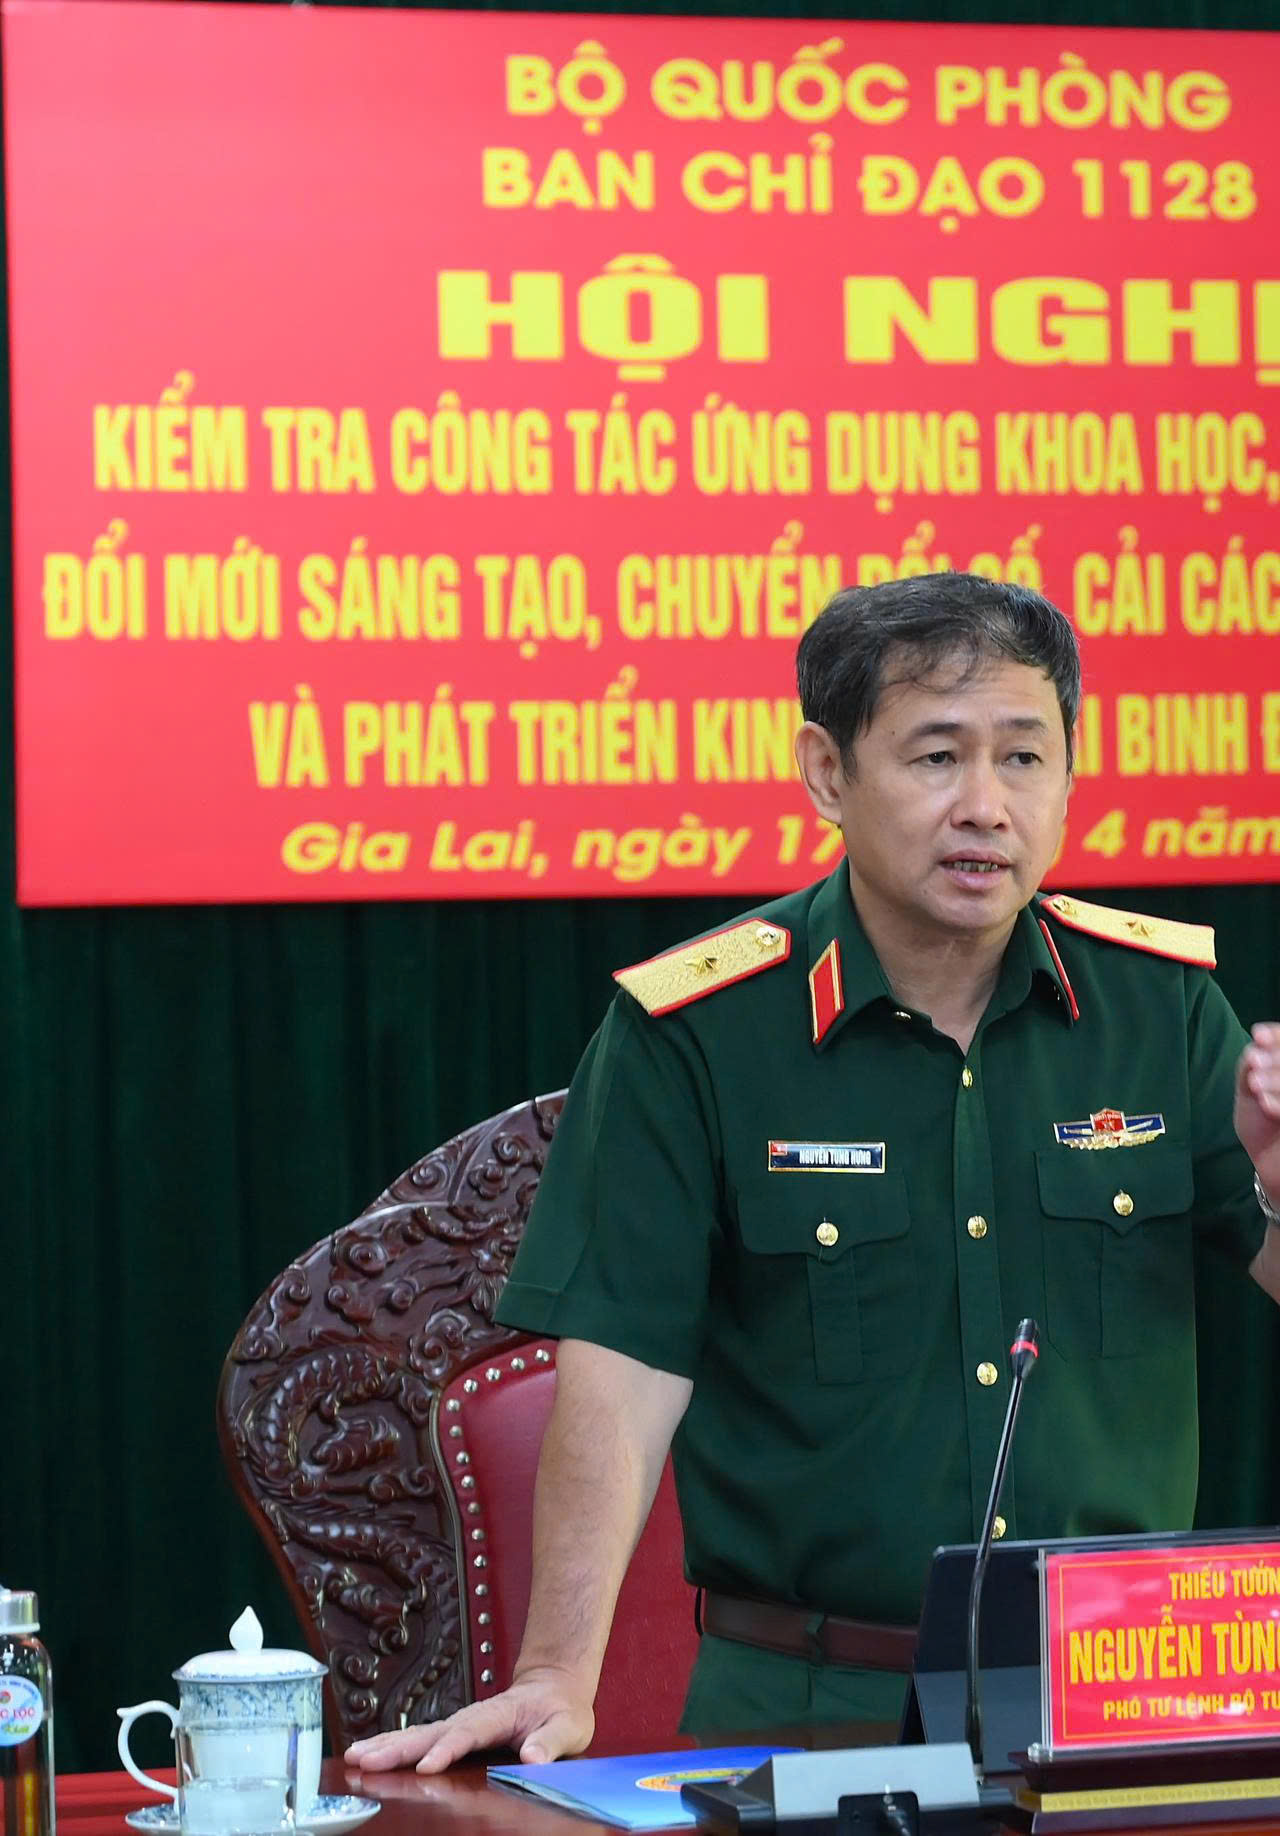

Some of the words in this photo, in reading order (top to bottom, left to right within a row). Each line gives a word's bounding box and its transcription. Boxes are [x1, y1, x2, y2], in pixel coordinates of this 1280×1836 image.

[506, 39, 625, 135] BỘ
[650, 38, 910, 125] QUỐC
[935, 52, 1232, 132] PHÒNG
[482, 146, 657, 212] BAN
[681, 132, 834, 214] CHỈ
[857, 154, 1046, 233] ĐẠO
[1073, 159, 1258, 221] 1128
[436, 253, 770, 383] HỘI
[93, 370, 249, 493] KIỂM
[262, 406, 377, 494] TRA
[390, 391, 553, 497] CÔNG
[566, 393, 678, 497] TÁC
[691, 391, 813, 497] ỨNG
[826, 410, 982, 514] DỤNG
[995, 411, 1144, 497] KHOA
[42, 519, 147, 641] ĐỔI
[163, 535, 282, 641] MỚI
[298, 535, 462, 642] SÁNG
[474, 553, 603, 660] TẠO,
[617, 519, 843, 641] CHUYỂN
[1073, 525, 1166, 637] CẢI
[246, 683, 330, 789] VÀ
[343, 682, 497, 788] PHÁT
[508, 666, 680, 785] TRIỂN
[692, 697, 808, 784] KIN
[1116, 692, 1249, 777] BINH
[281, 822, 411, 873] Gia
[430, 819, 550, 879] Lai,
[572, 815, 752, 883] ngày
[777, 815, 847, 865] 17
[1082, 809, 1127, 857] 4
[1168, 1561, 1226, 1601] THIẾU
[1069, 1604, 1203, 1685] NGUYỄN
[1103, 1695, 1142, 1721] PHÓ
[1147, 1695, 1173, 1718] TƯ
